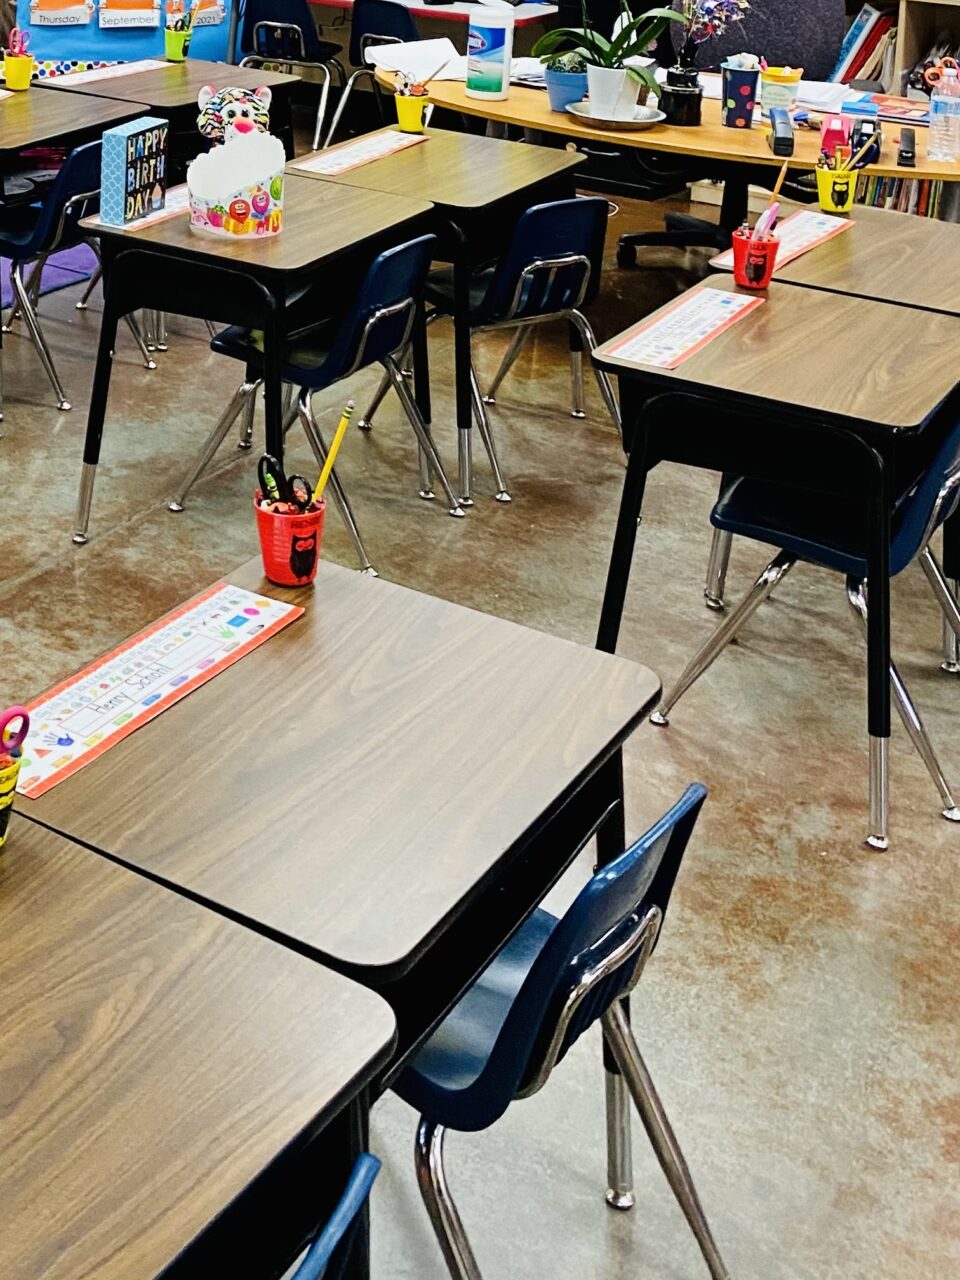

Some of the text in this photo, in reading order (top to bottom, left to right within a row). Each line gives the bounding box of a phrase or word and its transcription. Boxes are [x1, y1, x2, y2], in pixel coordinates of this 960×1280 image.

[40, 15, 80, 24] Thursday
[102, 16, 154, 26] September
[128, 128, 168, 161] HAPPY
[128, 155, 165, 192] BIRTH
[125, 191, 150, 219] DAY
